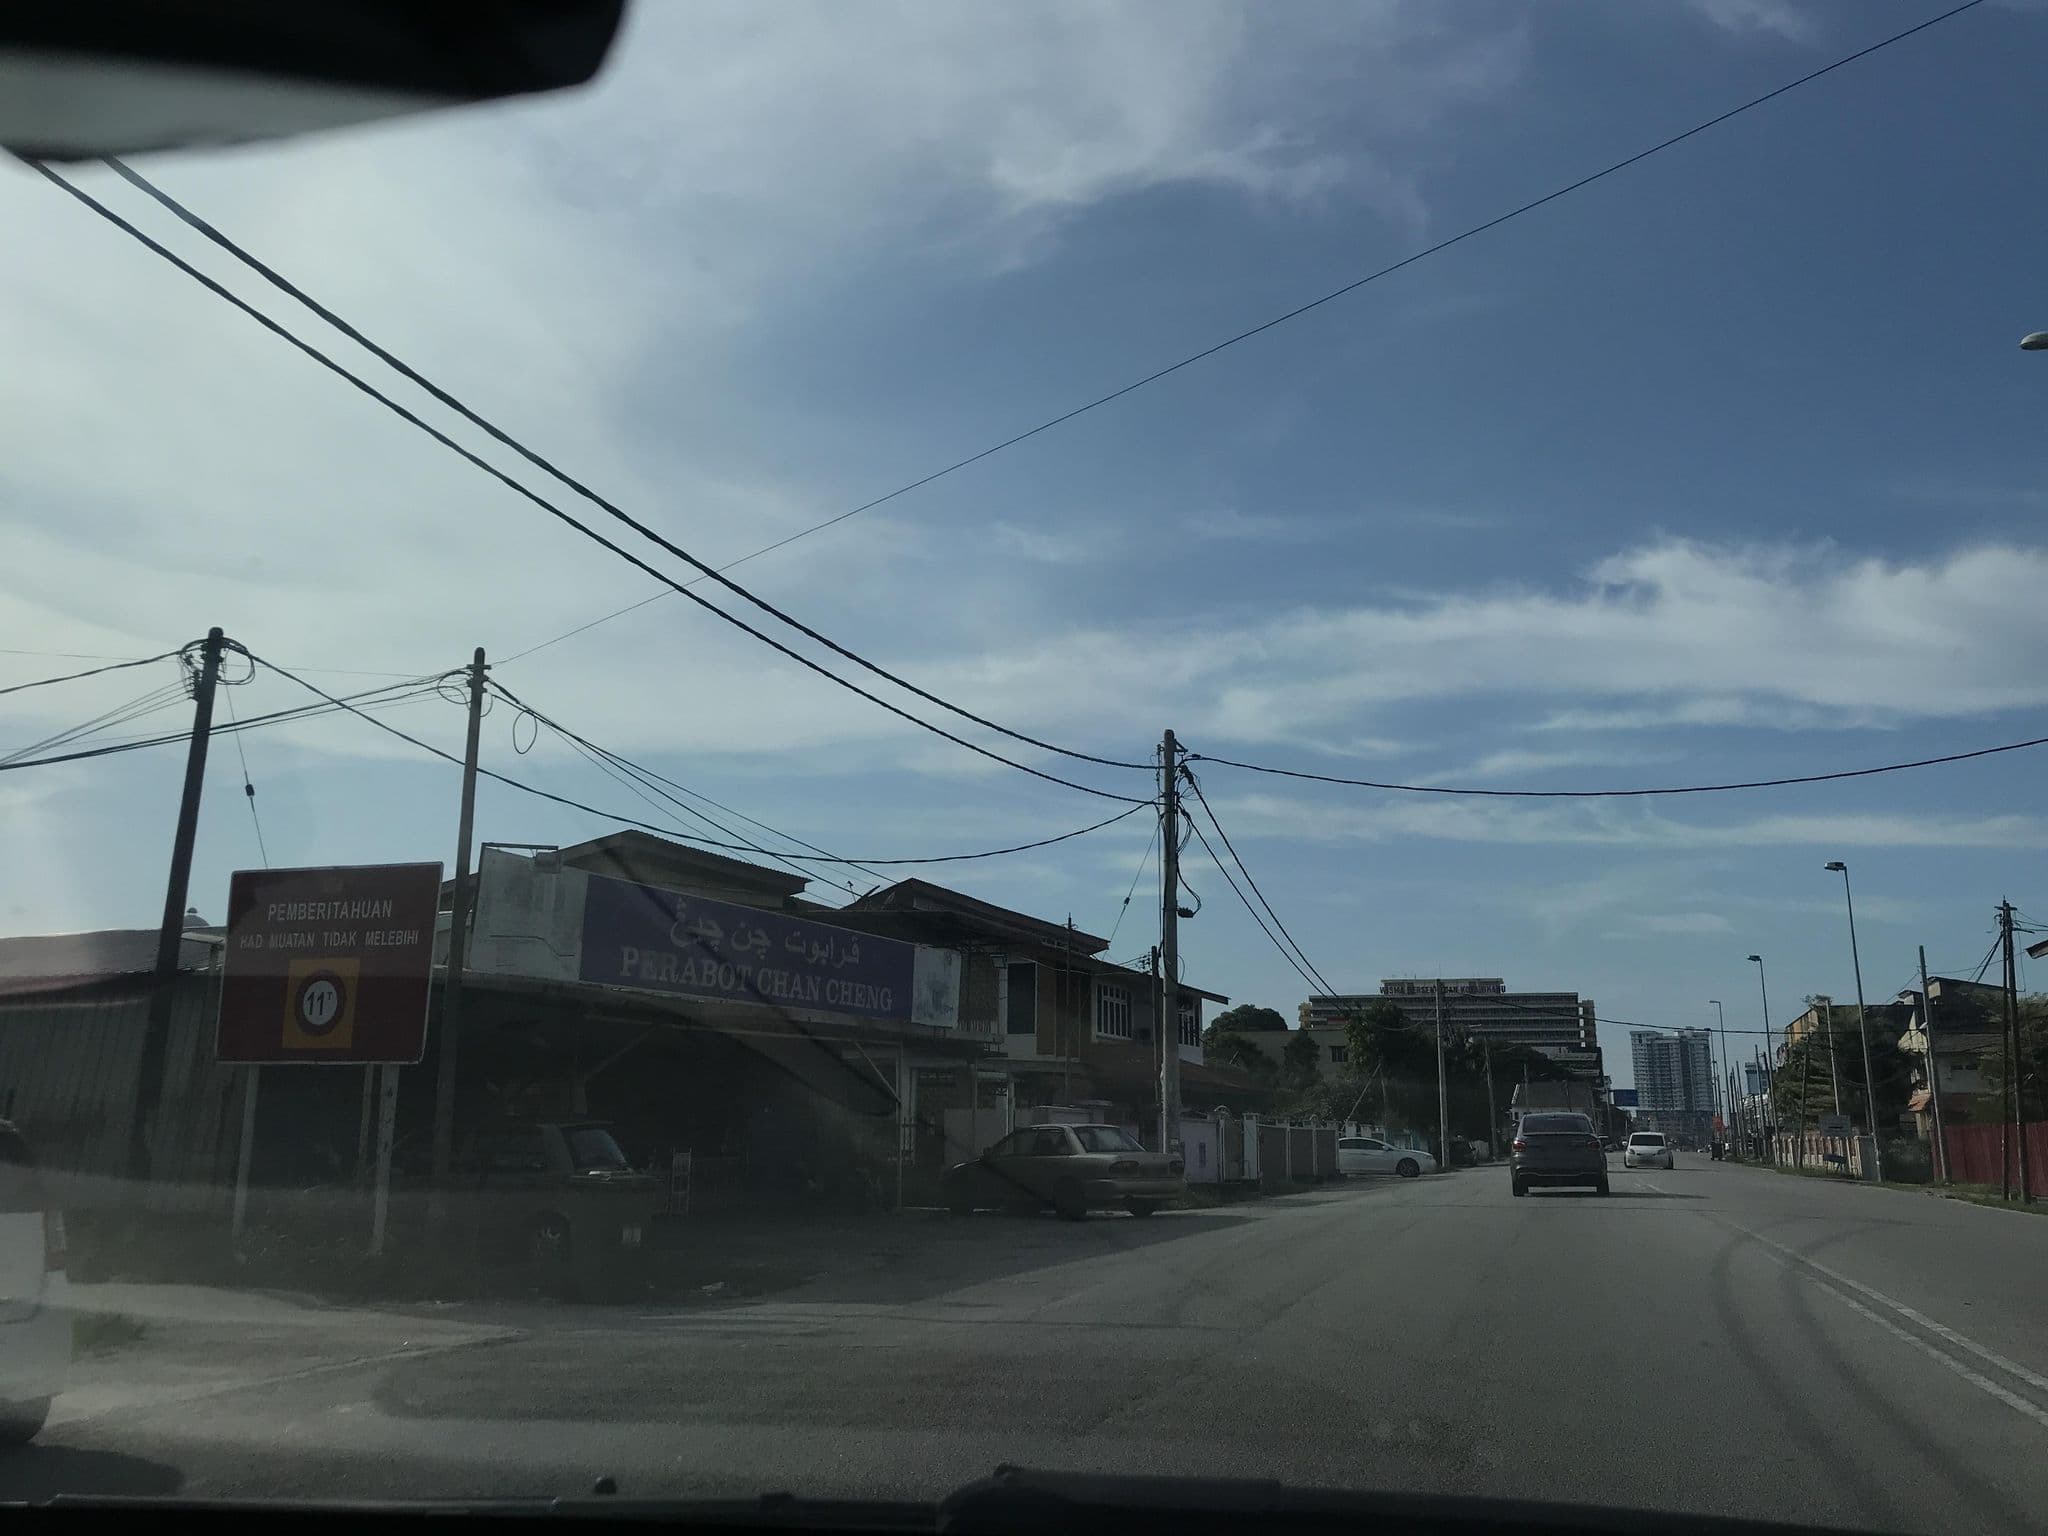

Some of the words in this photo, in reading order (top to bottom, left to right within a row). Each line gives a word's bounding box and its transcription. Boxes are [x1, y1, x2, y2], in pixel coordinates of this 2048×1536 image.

[268, 900, 392, 920] PEMBERITAHUAN
[240, 934, 263, 948] HAD
[270, 932, 315, 948] MUATAN
[323, 930, 357, 947] TIDAK
[365, 929, 420, 946] MELEBIHI
[619, 944, 752, 992] PERABOT
[757, 967, 821, 1002] CHAN
[825, 977, 894, 1012] CHENG
